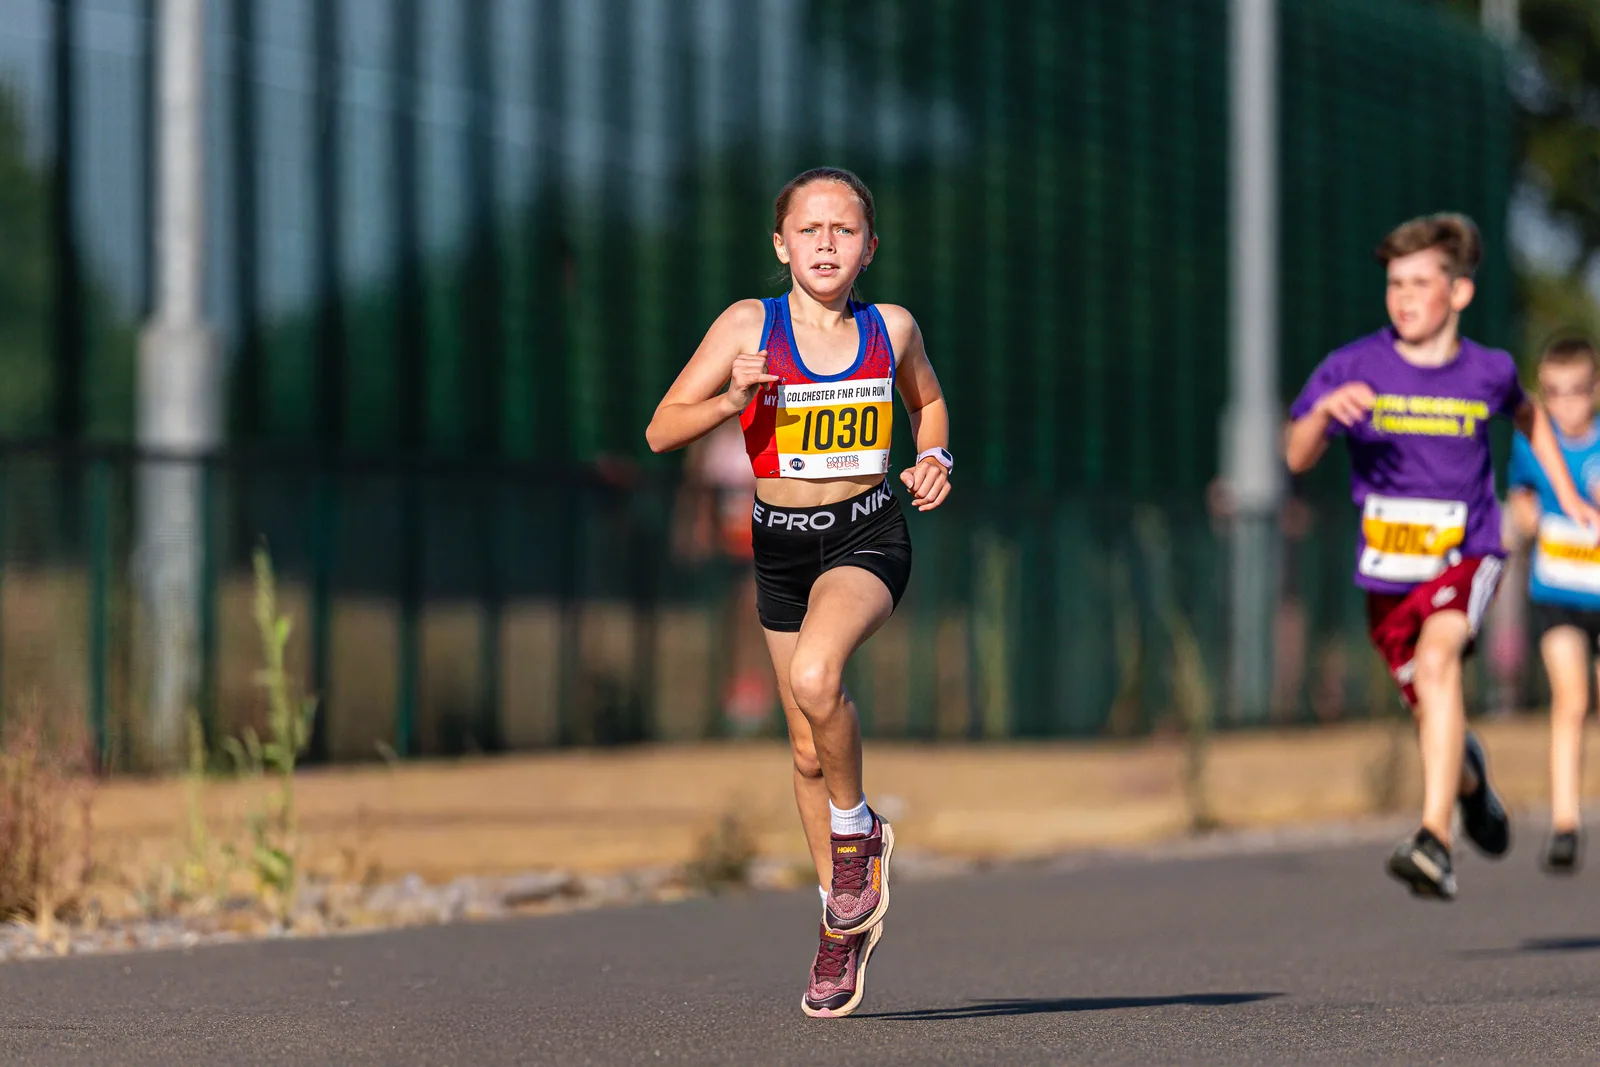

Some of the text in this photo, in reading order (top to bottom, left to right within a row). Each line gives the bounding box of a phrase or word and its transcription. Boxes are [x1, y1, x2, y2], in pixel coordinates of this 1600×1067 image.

[786, 386, 886, 402] COLCHESTER FNR FUN RUN
[801, 405, 878, 451] 1030
[826, 454, 859, 464] comms
[826, 460, 860, 470] express
[767, 511, 836, 531] PRO
[837, 846, 857, 854] HOKA
